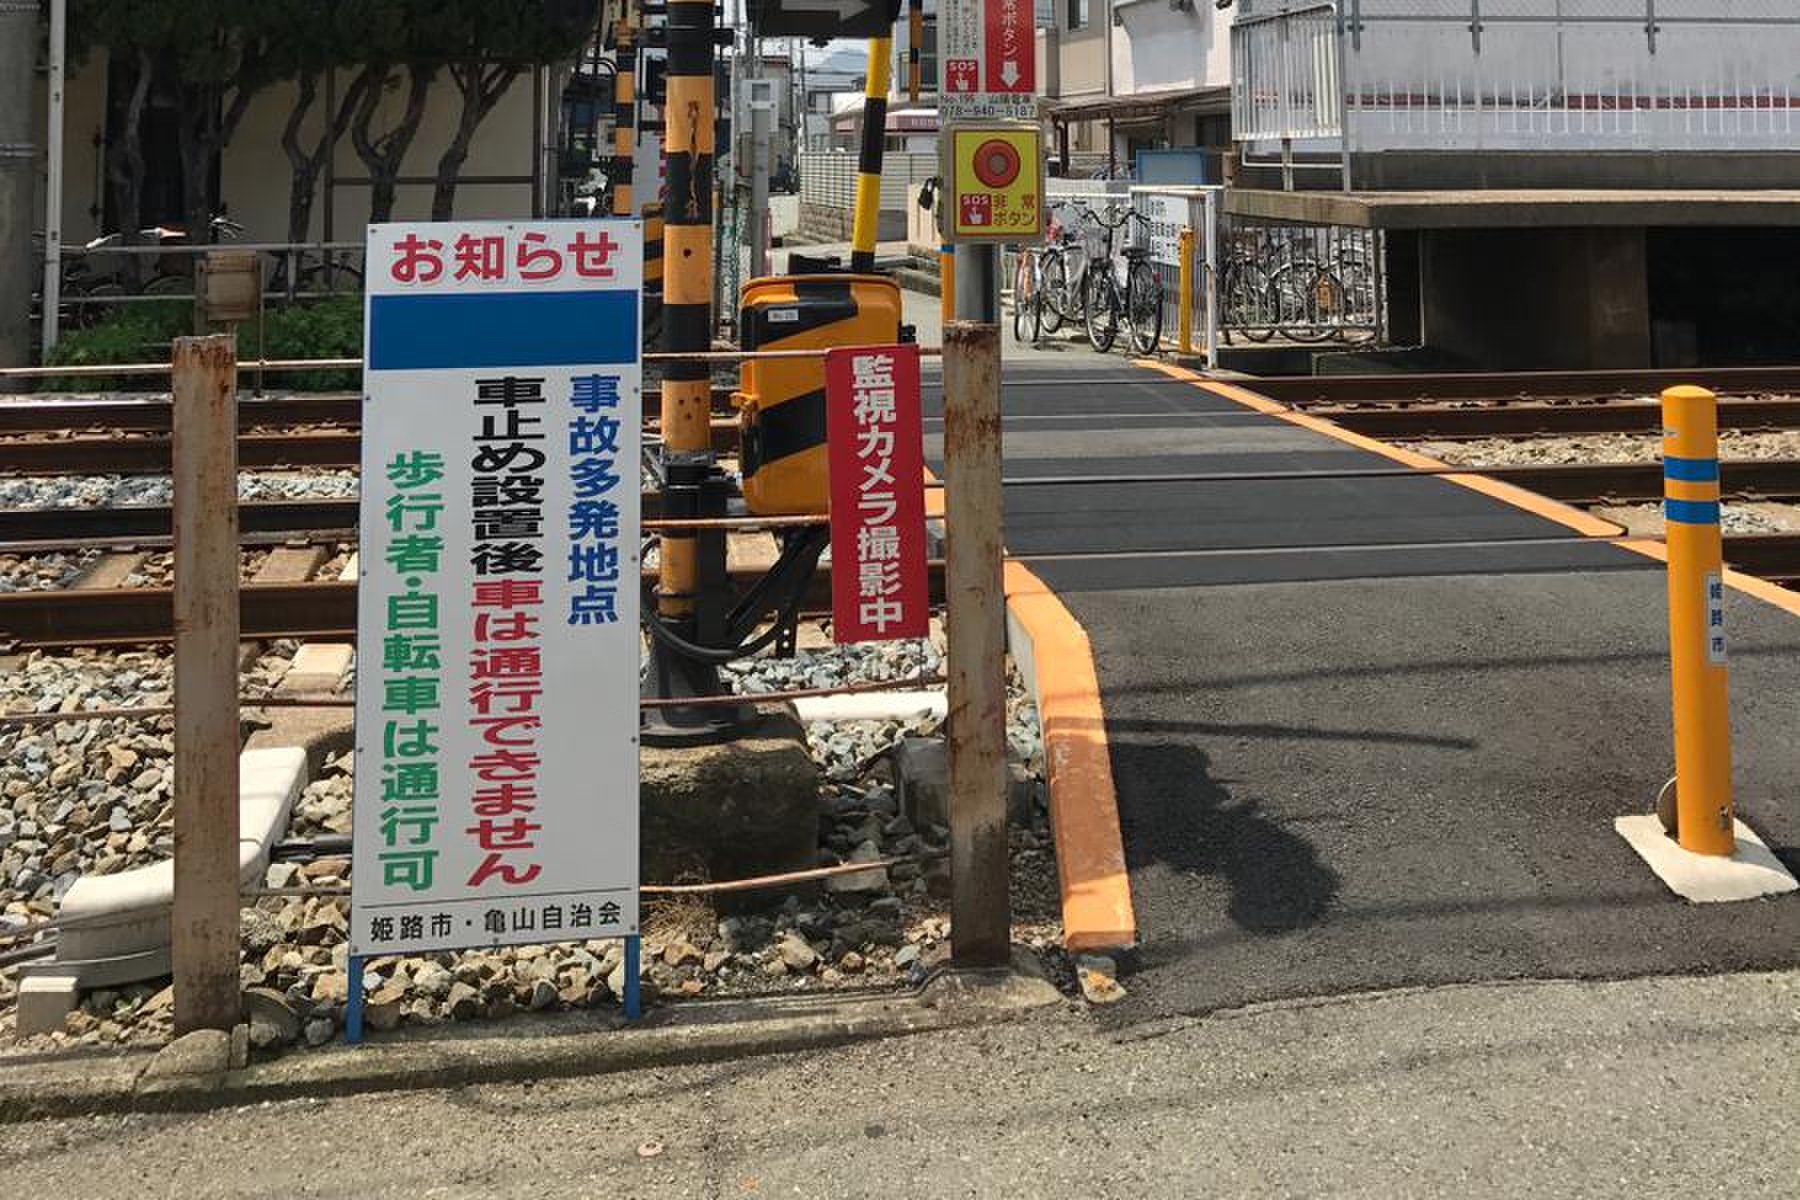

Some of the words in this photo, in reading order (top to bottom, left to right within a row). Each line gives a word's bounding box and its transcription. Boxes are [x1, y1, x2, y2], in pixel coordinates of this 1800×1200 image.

[949, 62, 976, 71] SOS
[962, 195, 989, 205] SOS
[993, 211, 1035, 226] ボタン
[390, 231, 619, 283] お知らせ
[567, 374, 621, 625] 事故多発地点
[852, 355, 903, 634] 監視カメラ撮影中
[378, 451, 444, 891] 歩行者・自転車は通行可
